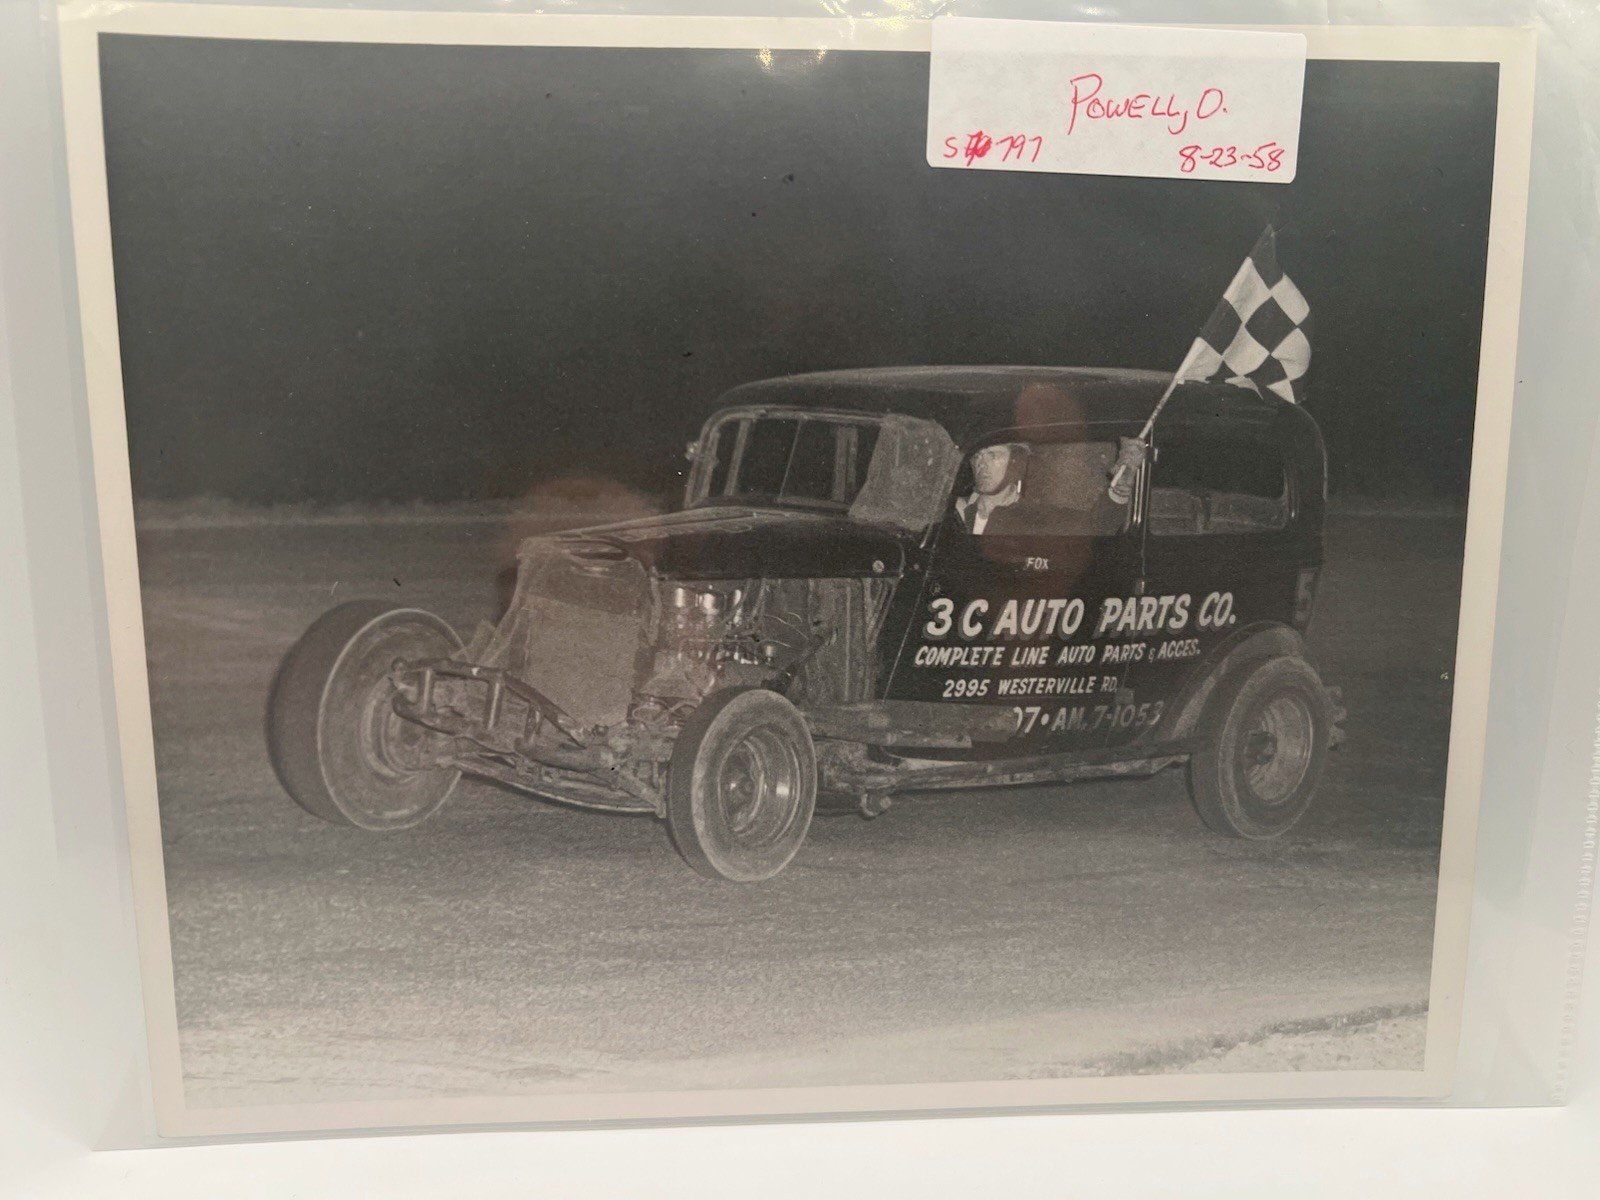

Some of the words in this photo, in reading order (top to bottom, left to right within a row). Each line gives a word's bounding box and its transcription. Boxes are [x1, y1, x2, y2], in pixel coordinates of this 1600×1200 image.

[1178, 142, 1284, 173] 8-23-58
[1025, 556, 1050, 570] FOX
[926, 598, 954, 636] 3
[961, 599, 989, 638] C
[993, 598, 1085, 636] AUTO
[1099, 594, 1192, 634] PARTS
[1198, 591, 1237, 627] CO.
[914, 645, 1006, 667] COMPLETE
[1010, 646, 1050, 666] LINE
[1056, 645, 1097, 665] AUTO
[1101, 643, 1147, 663] PARTS
[1157, 638, 1201, 660] ACCES.
[942, 679, 991, 698] 2995
[997, 675, 1098, 696] WESTERVILLE
[1100, 675, 1119, 693] RD.
